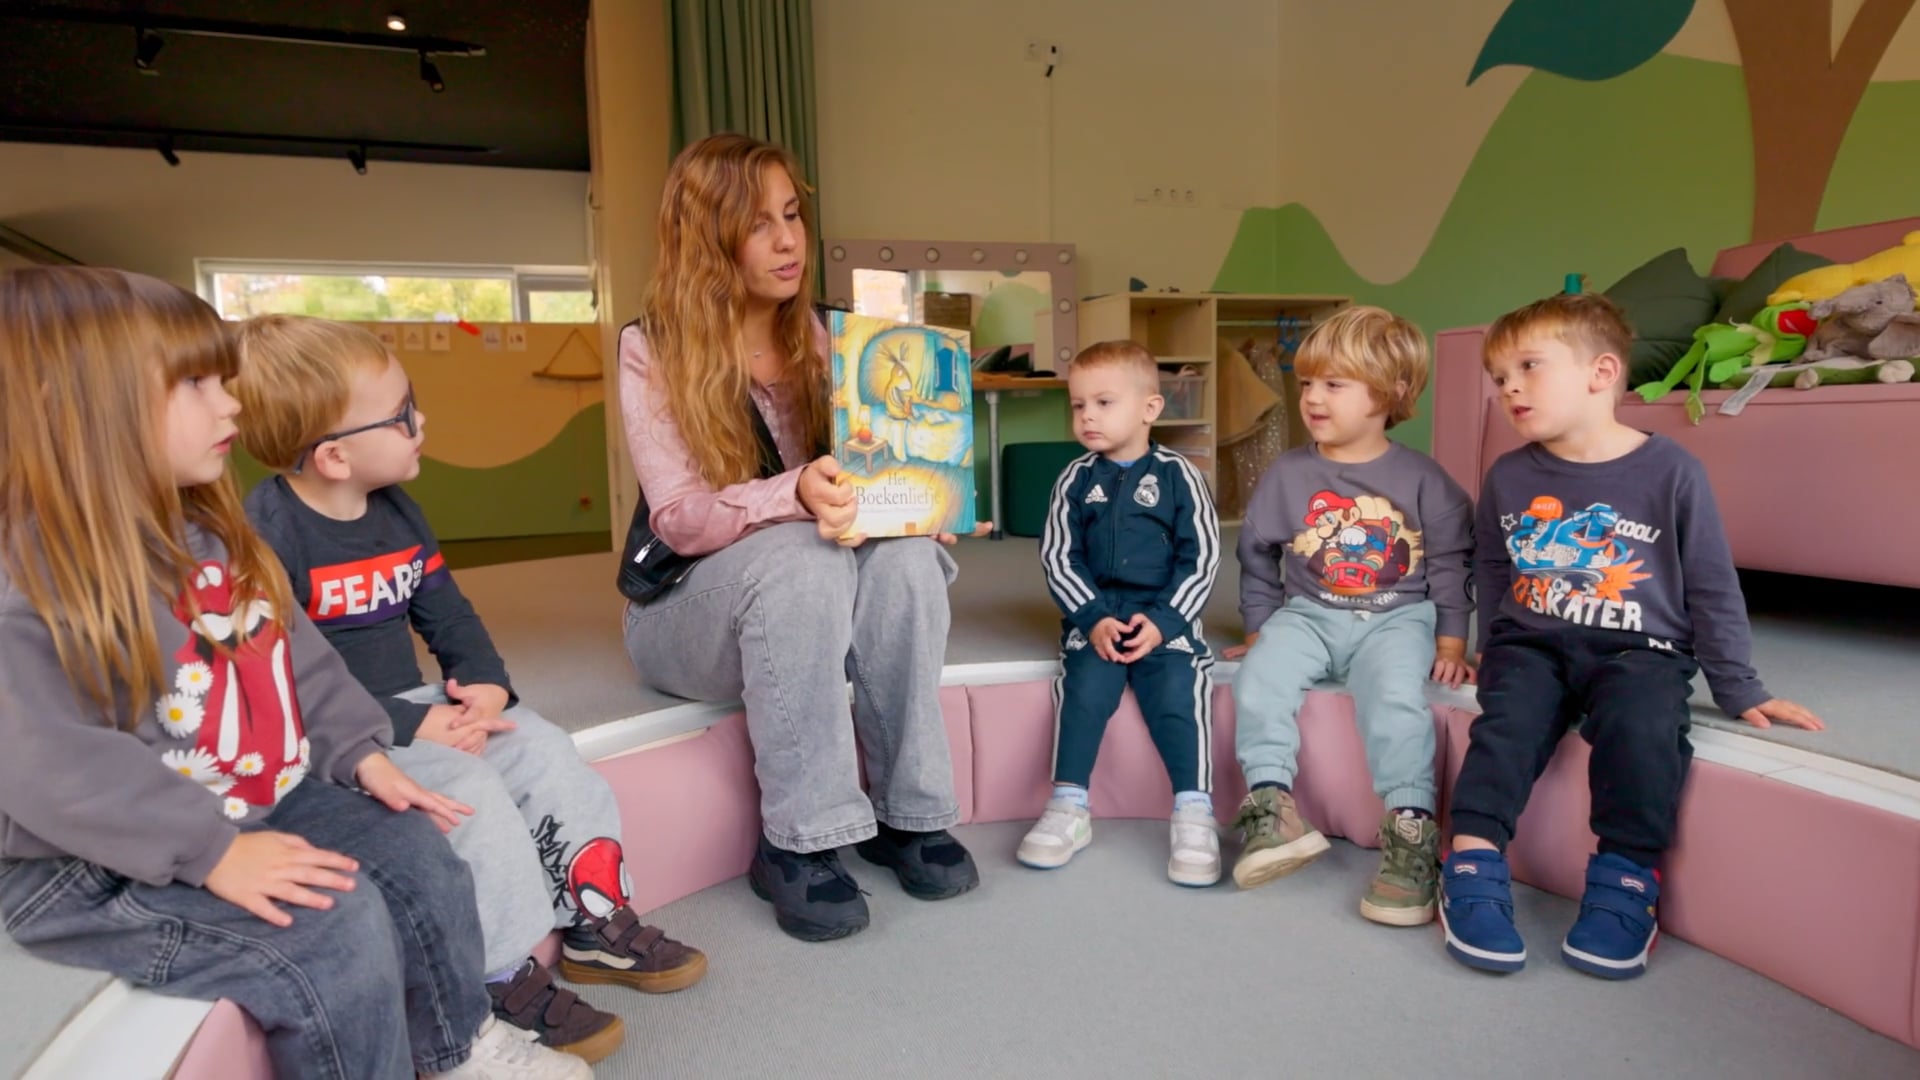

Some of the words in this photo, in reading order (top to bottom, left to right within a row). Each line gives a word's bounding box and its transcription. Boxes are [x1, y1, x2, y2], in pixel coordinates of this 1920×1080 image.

[888, 472, 907, 486] Het
[856, 485, 941, 511] Boekenliefje
[318, 563, 413, 616] FEAR
[1530, 584, 1642, 632] SKATER
